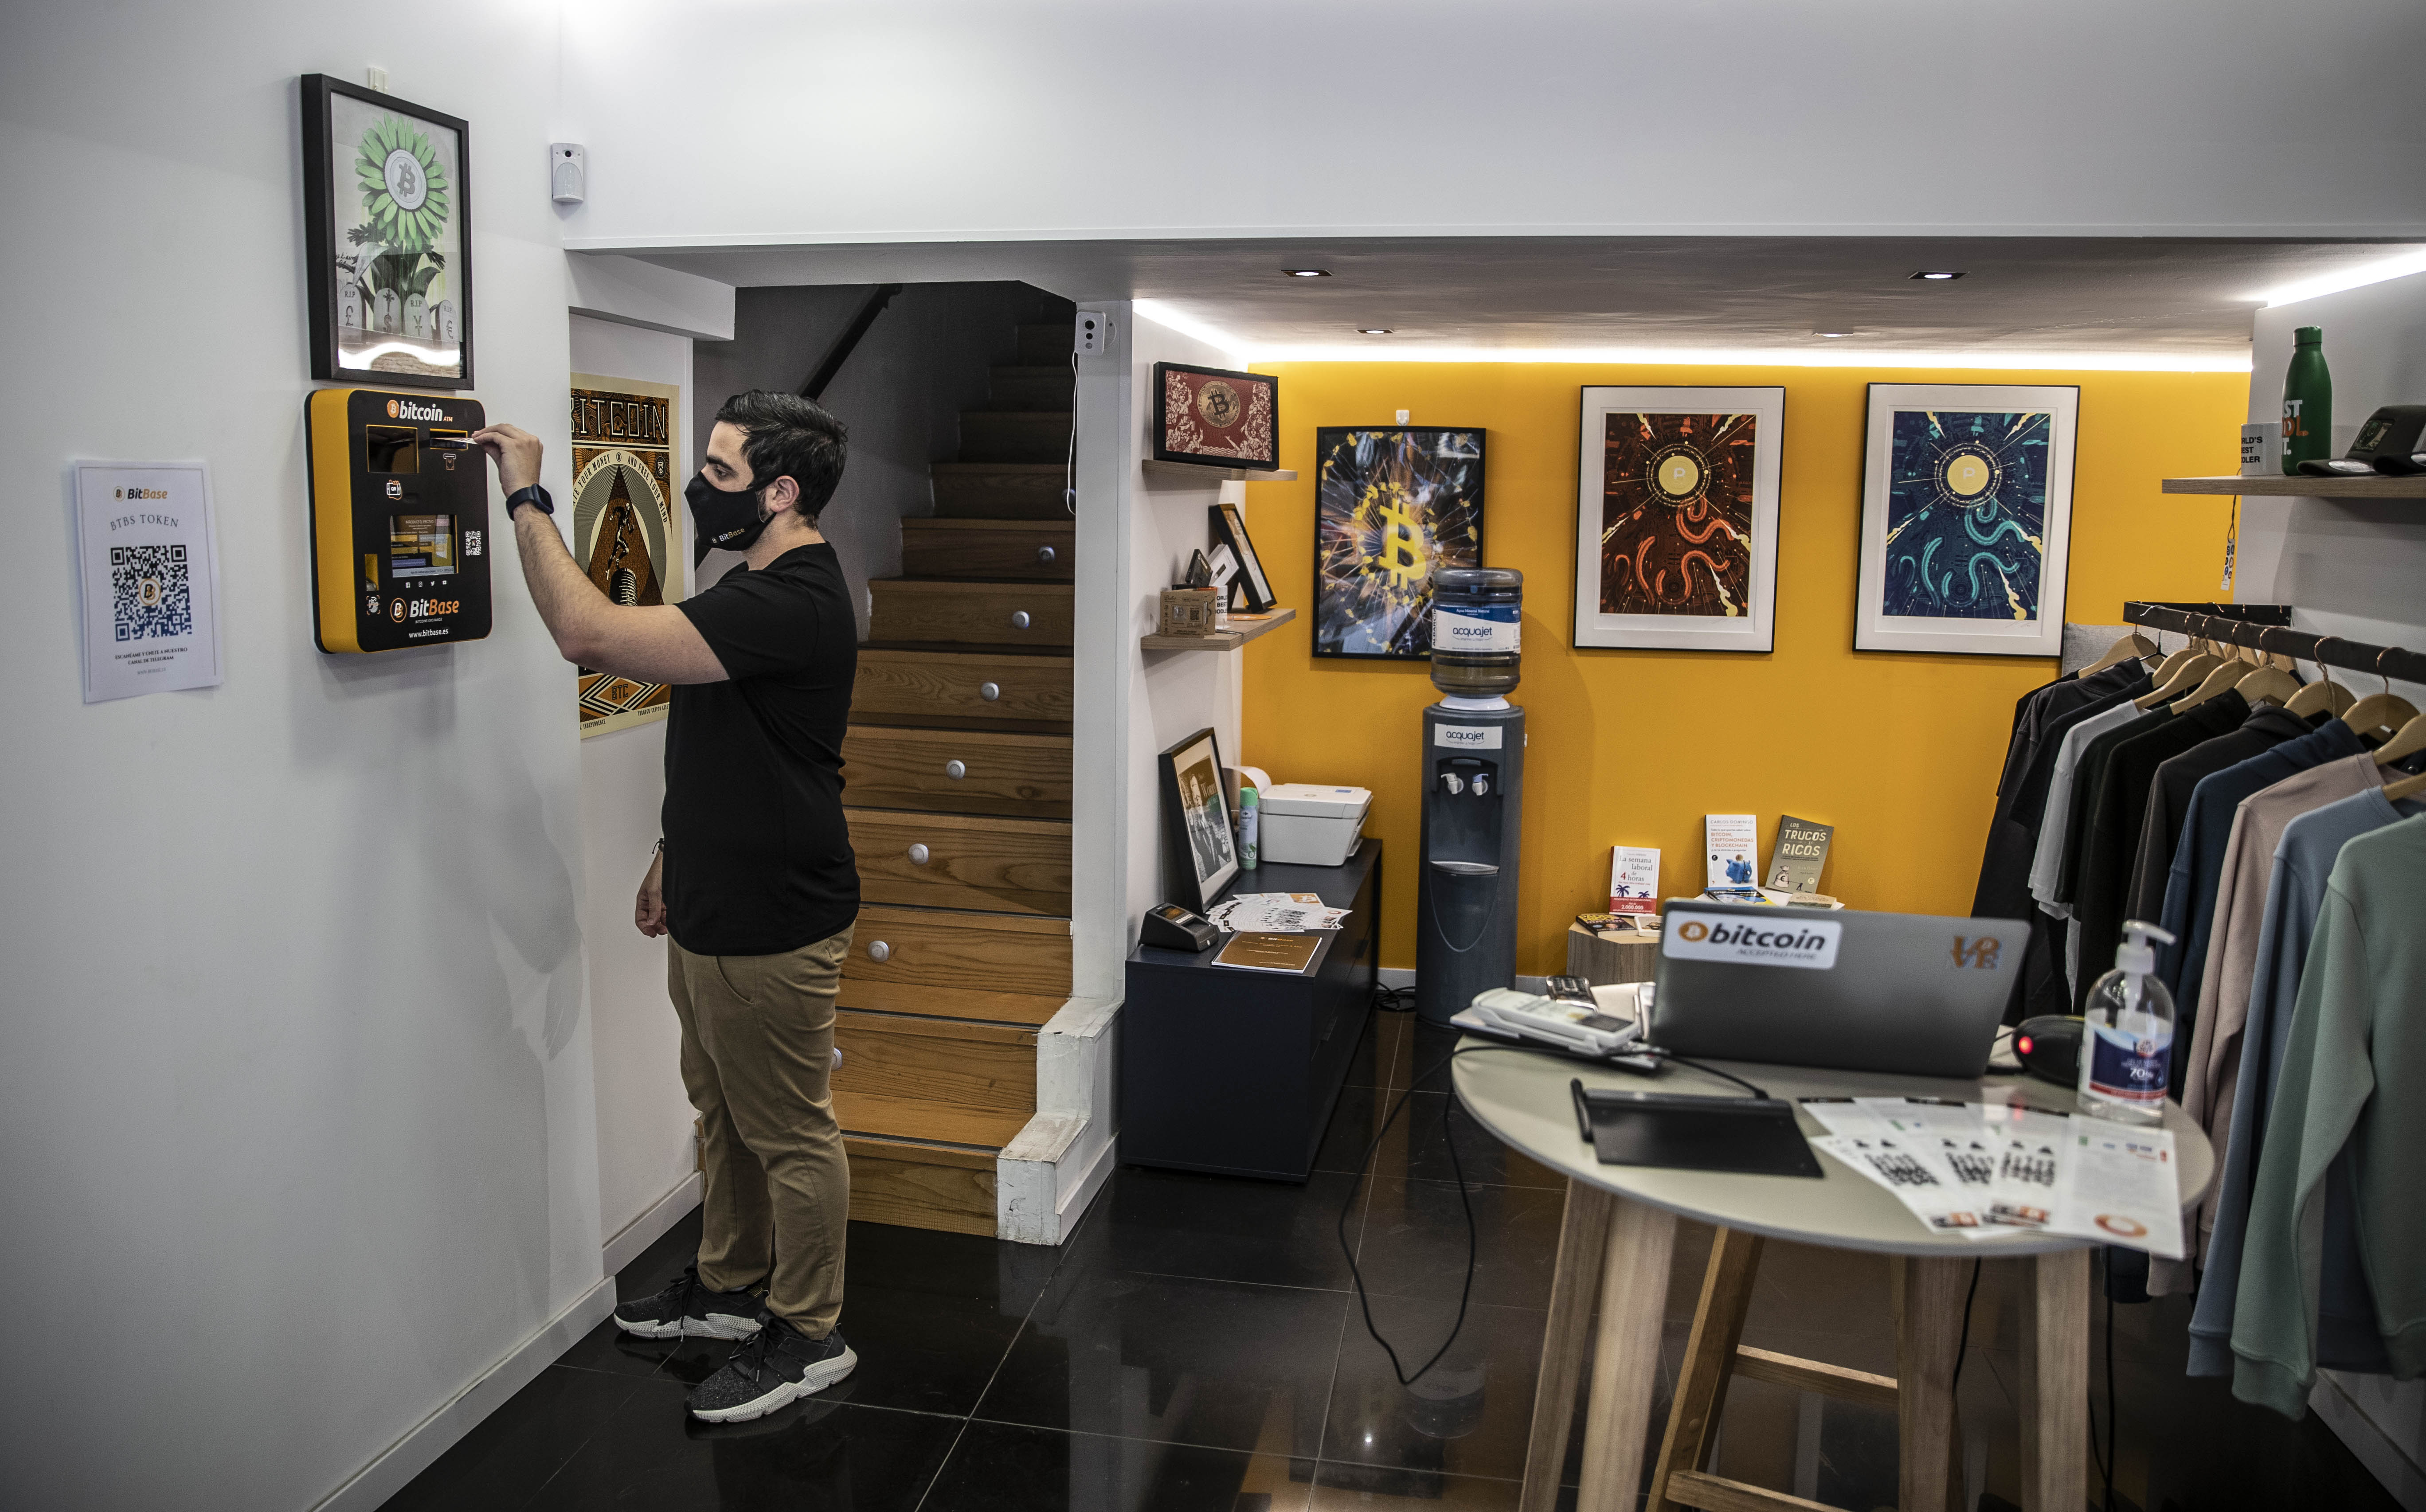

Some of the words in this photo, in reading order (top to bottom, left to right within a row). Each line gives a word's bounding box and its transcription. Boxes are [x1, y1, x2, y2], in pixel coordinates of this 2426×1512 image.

[399, 401, 442, 422] bitcoin
[2284, 399, 2303, 418] ST
[571, 397, 665, 438] ITCOIN
[2282, 437, 2292, 455] T.
[127, 488, 168, 500] BitBase
[578, 468, 592, 488] YOUR
[592, 454, 610, 472] MONEY
[627, 456, 637, 467] AND
[638, 464, 649, 481] FREE
[650, 480, 661, 500] YOUR
[658, 501, 668, 523] MIND
[110, 515, 135, 531] BTBS
[140, 514, 179, 528] TOKEN
[719, 528, 745, 542] BitBase
[410, 598, 459, 617] BitBase
[409, 629, 449, 638] www.bitbase.es
[1452, 626, 1492, 637] acquajet
[611, 683, 628, 700] BTC
[583, 719, 606, 729] INDEPENDENCE
[1446, 731, 1484, 741] acquajet
[1785, 829, 1827, 841] TRUCOS
[1782, 843, 1821, 856] RICOS
[1709, 922, 1825, 950] bitcoin
[1736, 948, 1787, 958] ACCEPTED
